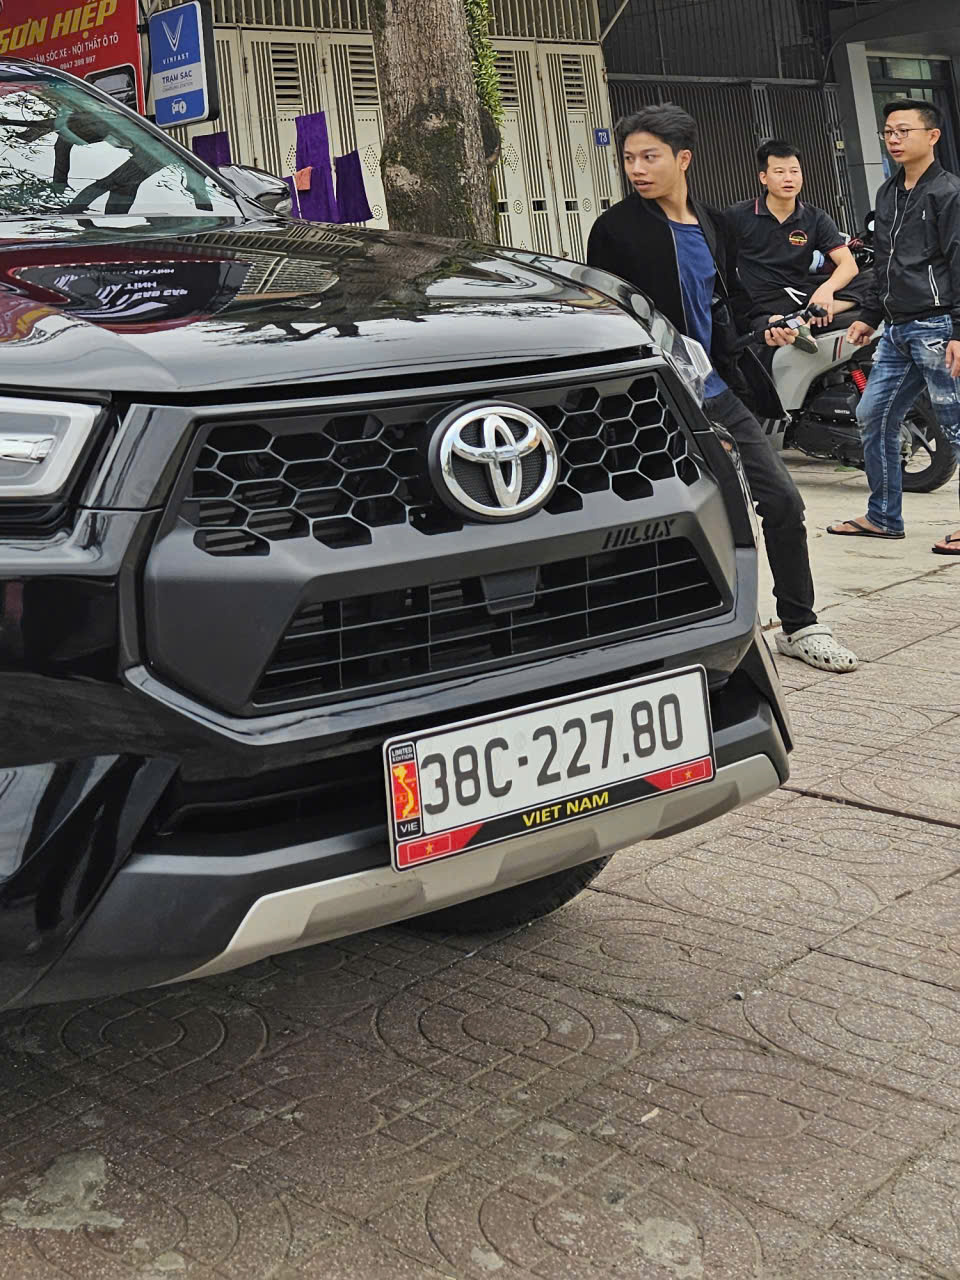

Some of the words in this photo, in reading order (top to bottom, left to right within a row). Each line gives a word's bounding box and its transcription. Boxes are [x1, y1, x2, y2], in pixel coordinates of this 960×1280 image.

[59, 47, 68, 58] XE
[71, 41, 84, 56] NỘI
[85, 34, 102, 51] THẤT
[102, 34, 109, 47] Ô
[109, 31, 119, 45] TÔ
[162, 52, 190, 65] VINFAST
[598, 131, 608, 143] 73
[601, 518, 677, 551] HILUX
[421, 692, 684, 816] 38C-227.80
[521, 804, 563, 828] VIET
[566, 791, 610, 815] NAM
[400, 821, 419, 833] VIE
